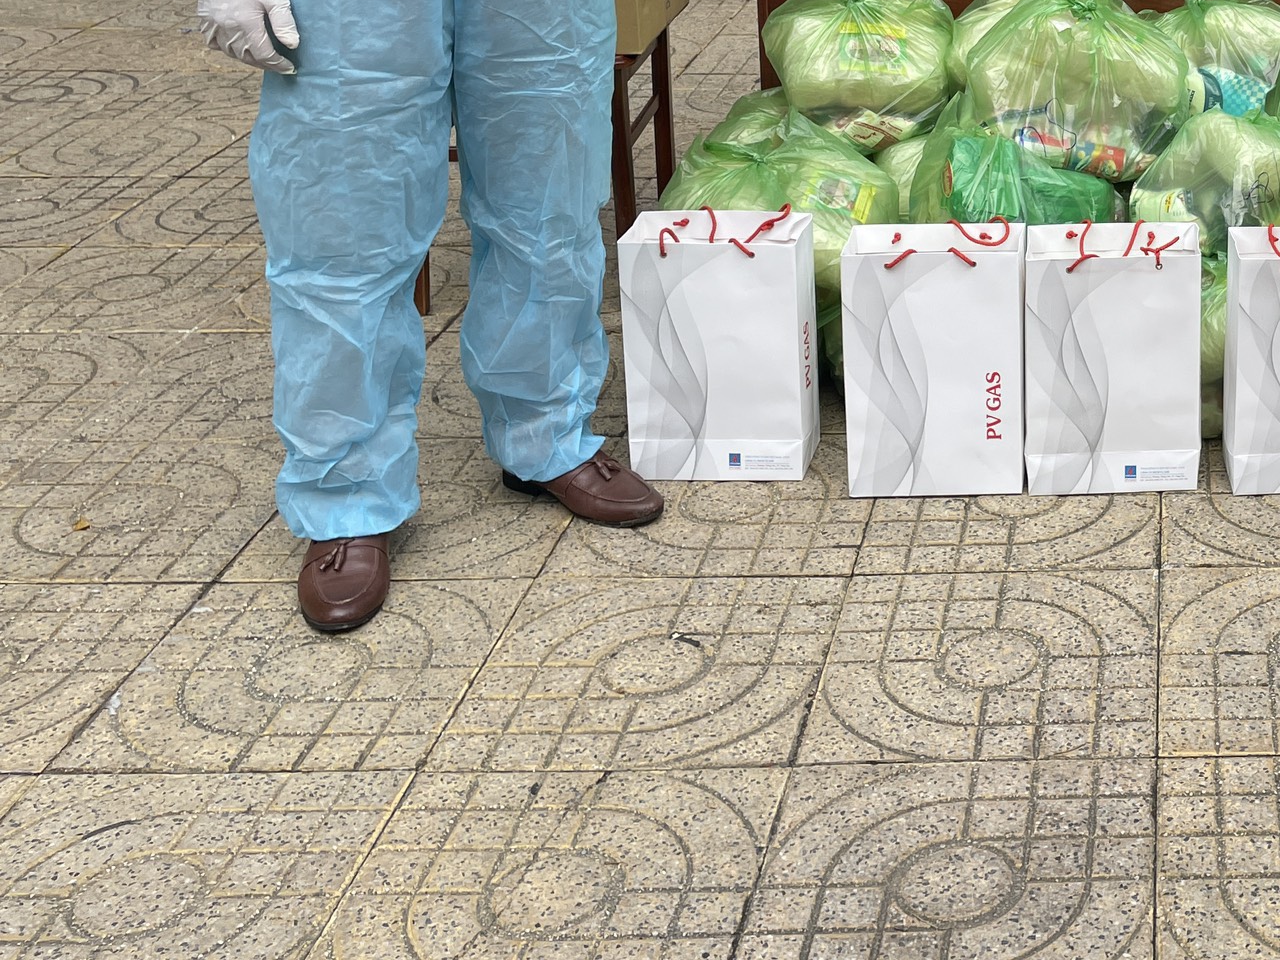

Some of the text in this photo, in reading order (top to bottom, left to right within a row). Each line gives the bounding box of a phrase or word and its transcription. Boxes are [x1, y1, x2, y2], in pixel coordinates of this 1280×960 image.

[803, 320, 812, 390] PV GAS
[985, 371, 1002, 440] PV GAS
